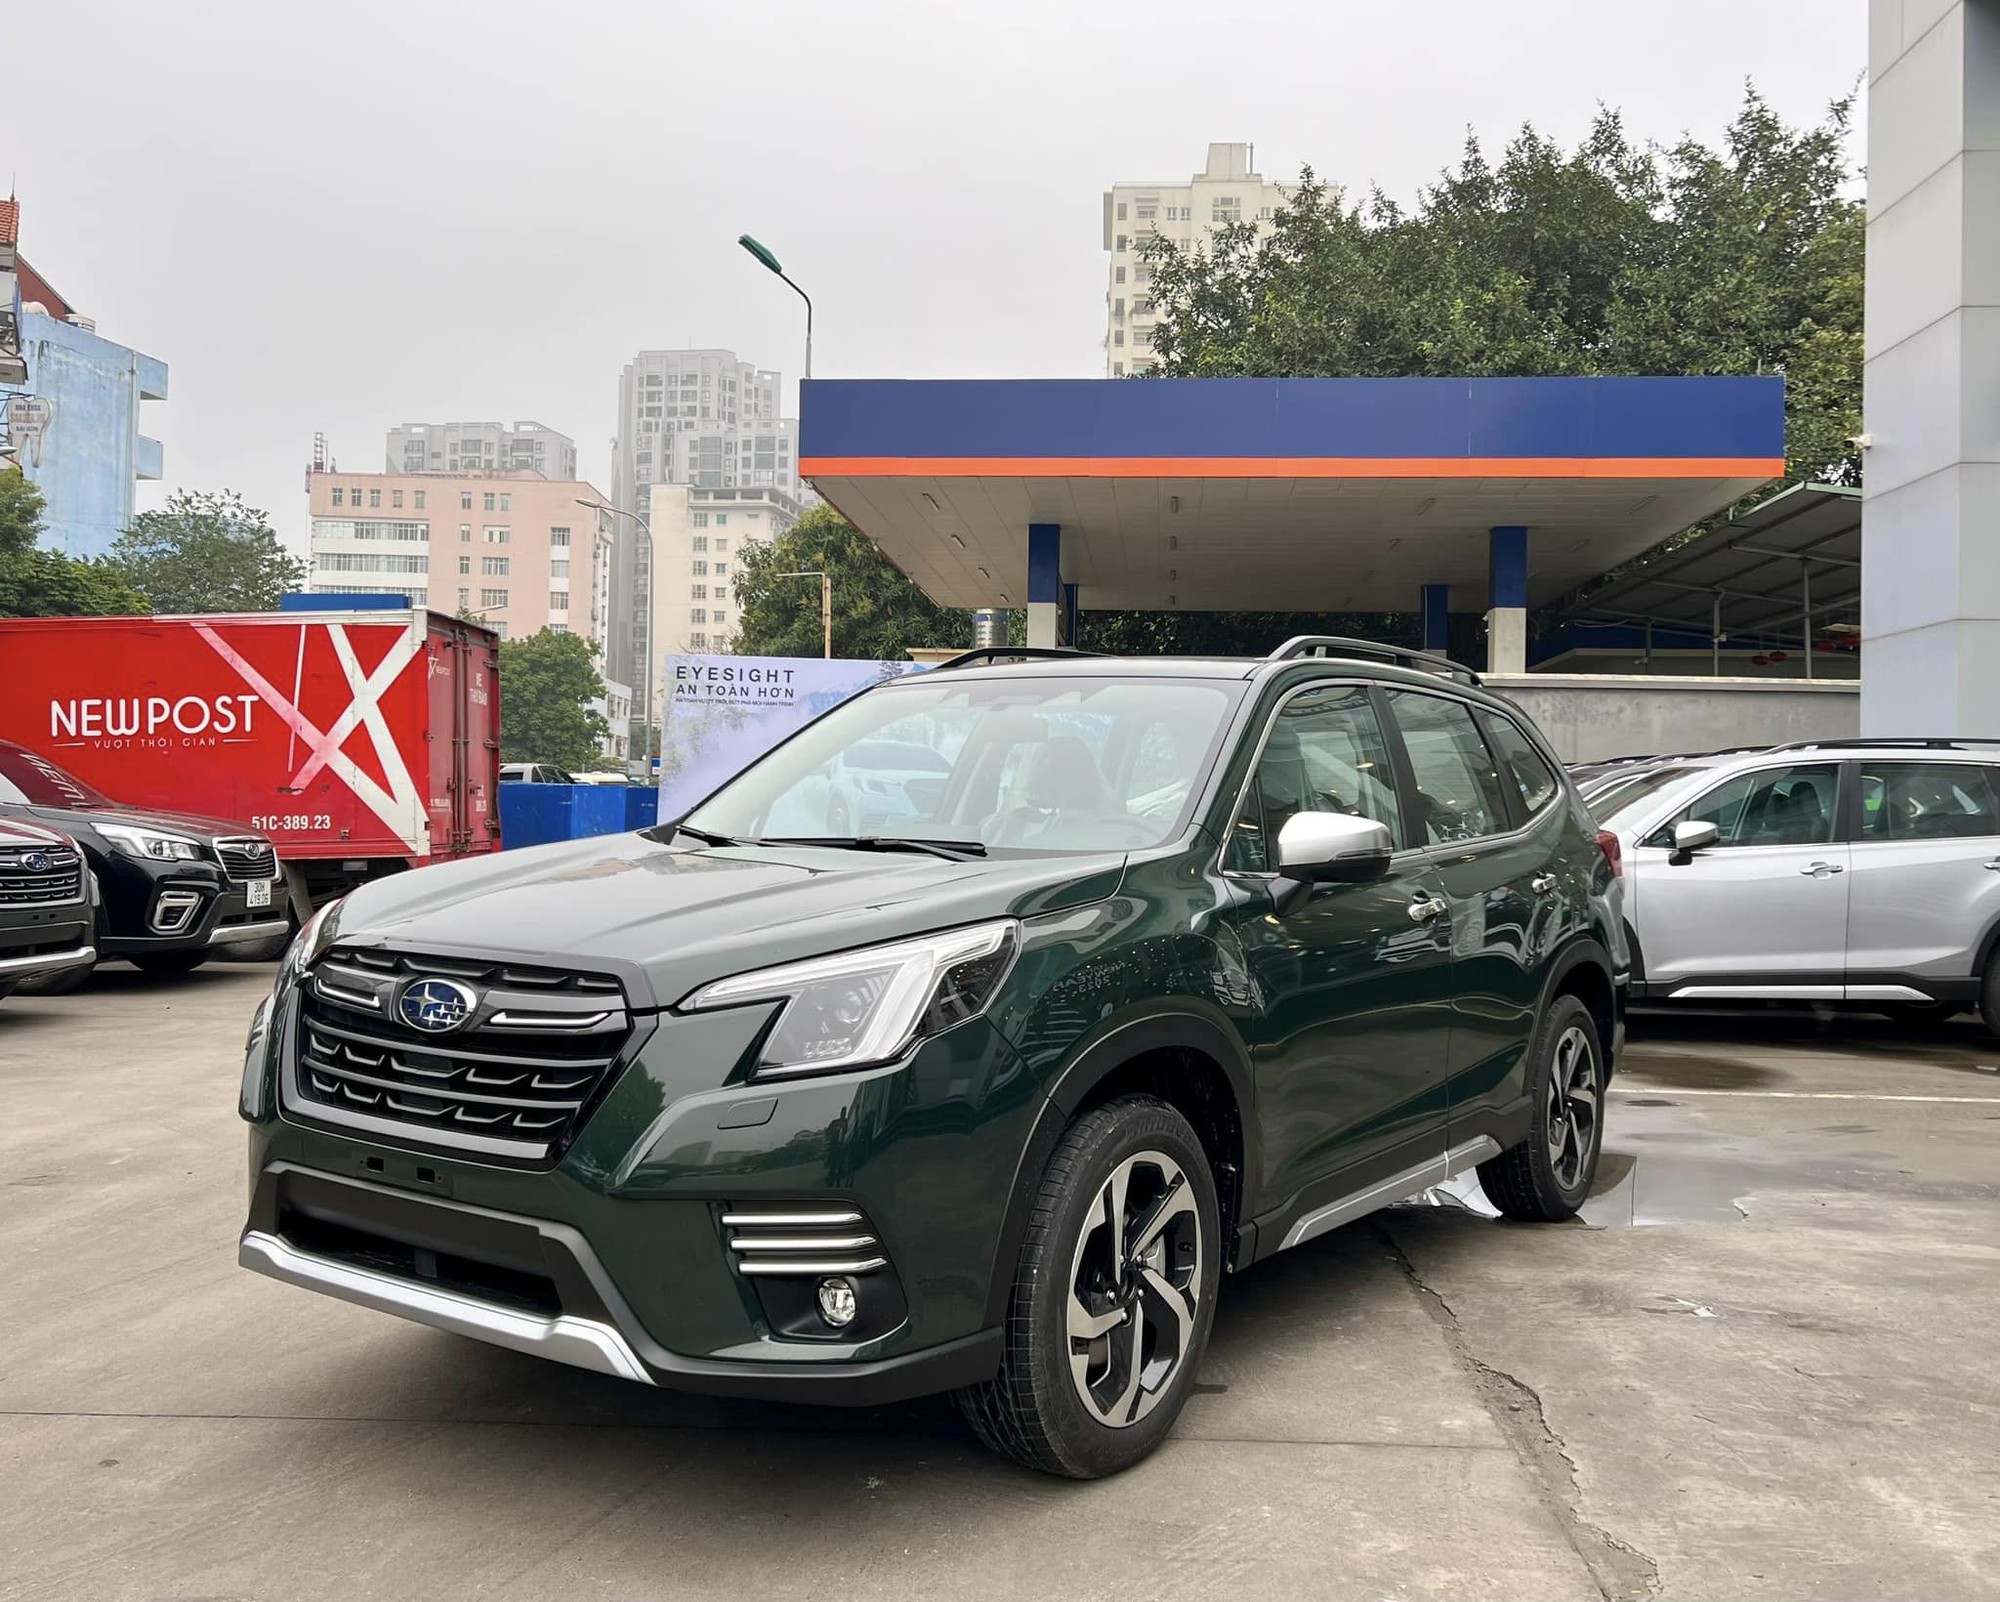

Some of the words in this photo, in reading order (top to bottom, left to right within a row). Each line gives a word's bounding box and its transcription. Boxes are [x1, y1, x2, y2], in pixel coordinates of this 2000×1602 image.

[676, 665, 794, 683] EYESIGHT
[676, 684, 697, 695] AN
[706, 682, 749, 697] TOÀN
[758, 687, 794, 699] HƠN
[51, 696, 260, 737] NEWPOST
[182, 737, 216, 747] GIAN
[251, 815, 331, 830] 51C-389.23
